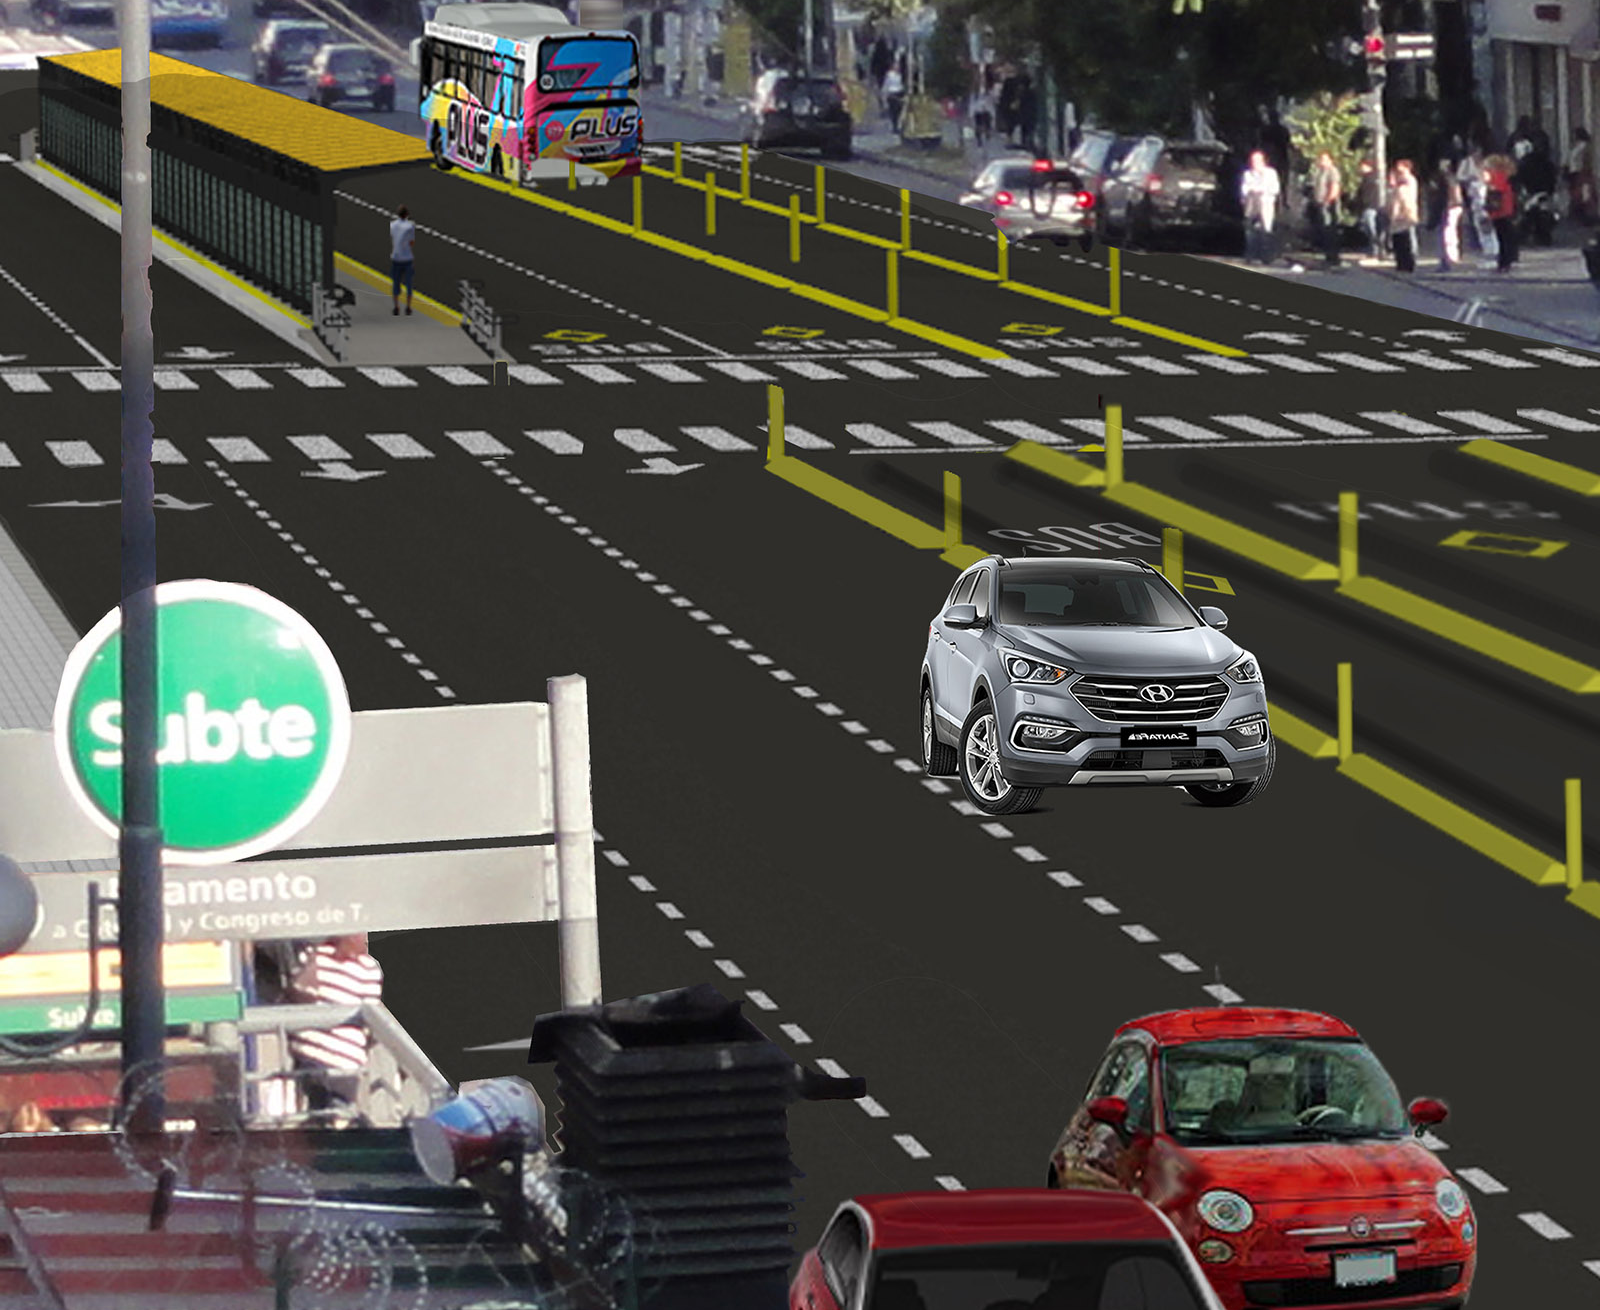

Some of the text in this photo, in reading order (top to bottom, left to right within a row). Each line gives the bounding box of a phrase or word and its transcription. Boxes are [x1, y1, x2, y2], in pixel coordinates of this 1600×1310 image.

[449, 102, 492, 165] PLUS
[570, 115, 636, 141] PLUS
[986, 521, 1162, 553] BUS
[88, 692, 315, 767] Subte
[53, 923, 66, 939] a
[179, 924, 194, 944] y
[200, 910, 311, 933] Congreso
[317, 902, 348, 924] de
